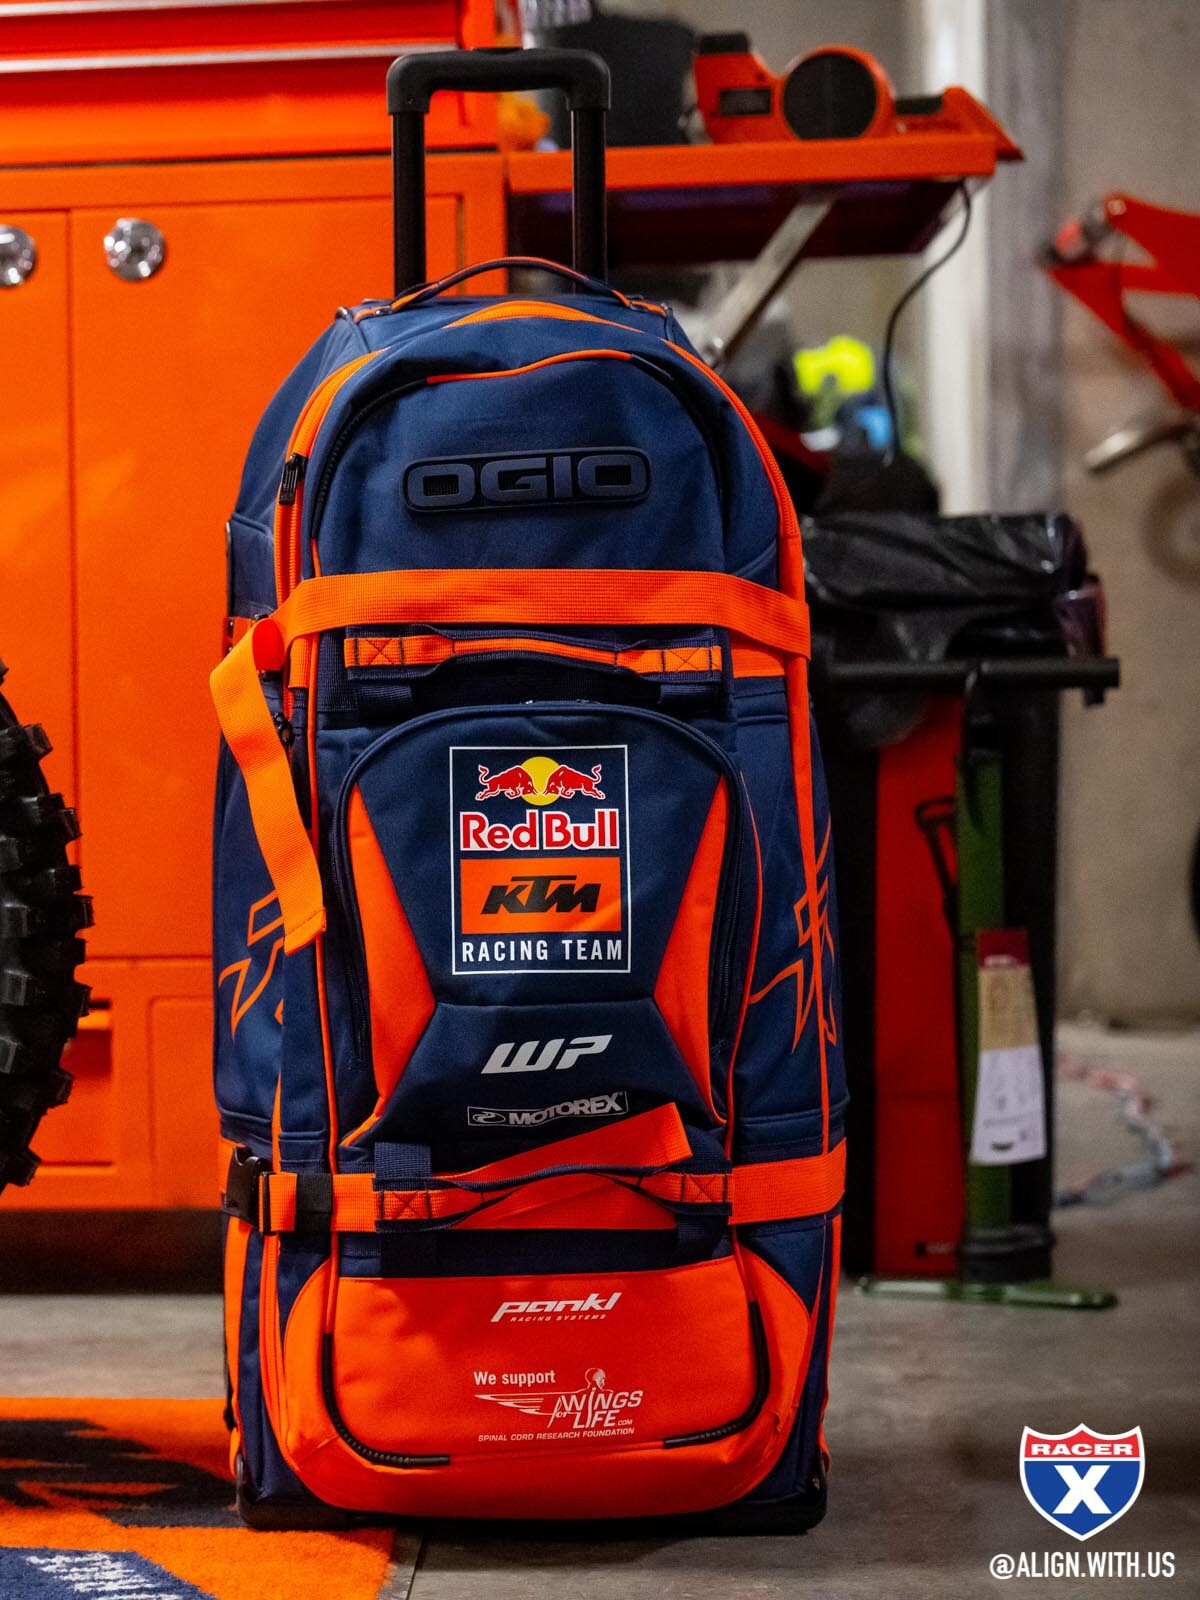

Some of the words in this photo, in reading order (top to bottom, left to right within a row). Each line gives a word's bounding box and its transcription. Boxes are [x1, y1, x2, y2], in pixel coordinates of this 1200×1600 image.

[406, 453, 649, 506] OGIO
[460, 809, 540, 851] Red
[542, 808, 620, 850] Bull
[481, 875, 602, 915] KTM
[462, 940, 548, 962] RACING
[562, 939, 622, 961] TEAM
[481, 1034, 613, 1075] WP
[508, 1092, 623, 1125] MOTOREX
[490, 1292, 623, 1323] pankl
[473, 1371, 497, 1386] We
[501, 1370, 556, 1388] support
[561, 1387, 644, 1411] WINGS
[478, 1434, 508, 1442] SPINAL
[510, 1433, 534, 1441] CORD
[536, 1431, 580, 1440] RESEARCH
[582, 1427, 635, 1438] FOUNDATION
